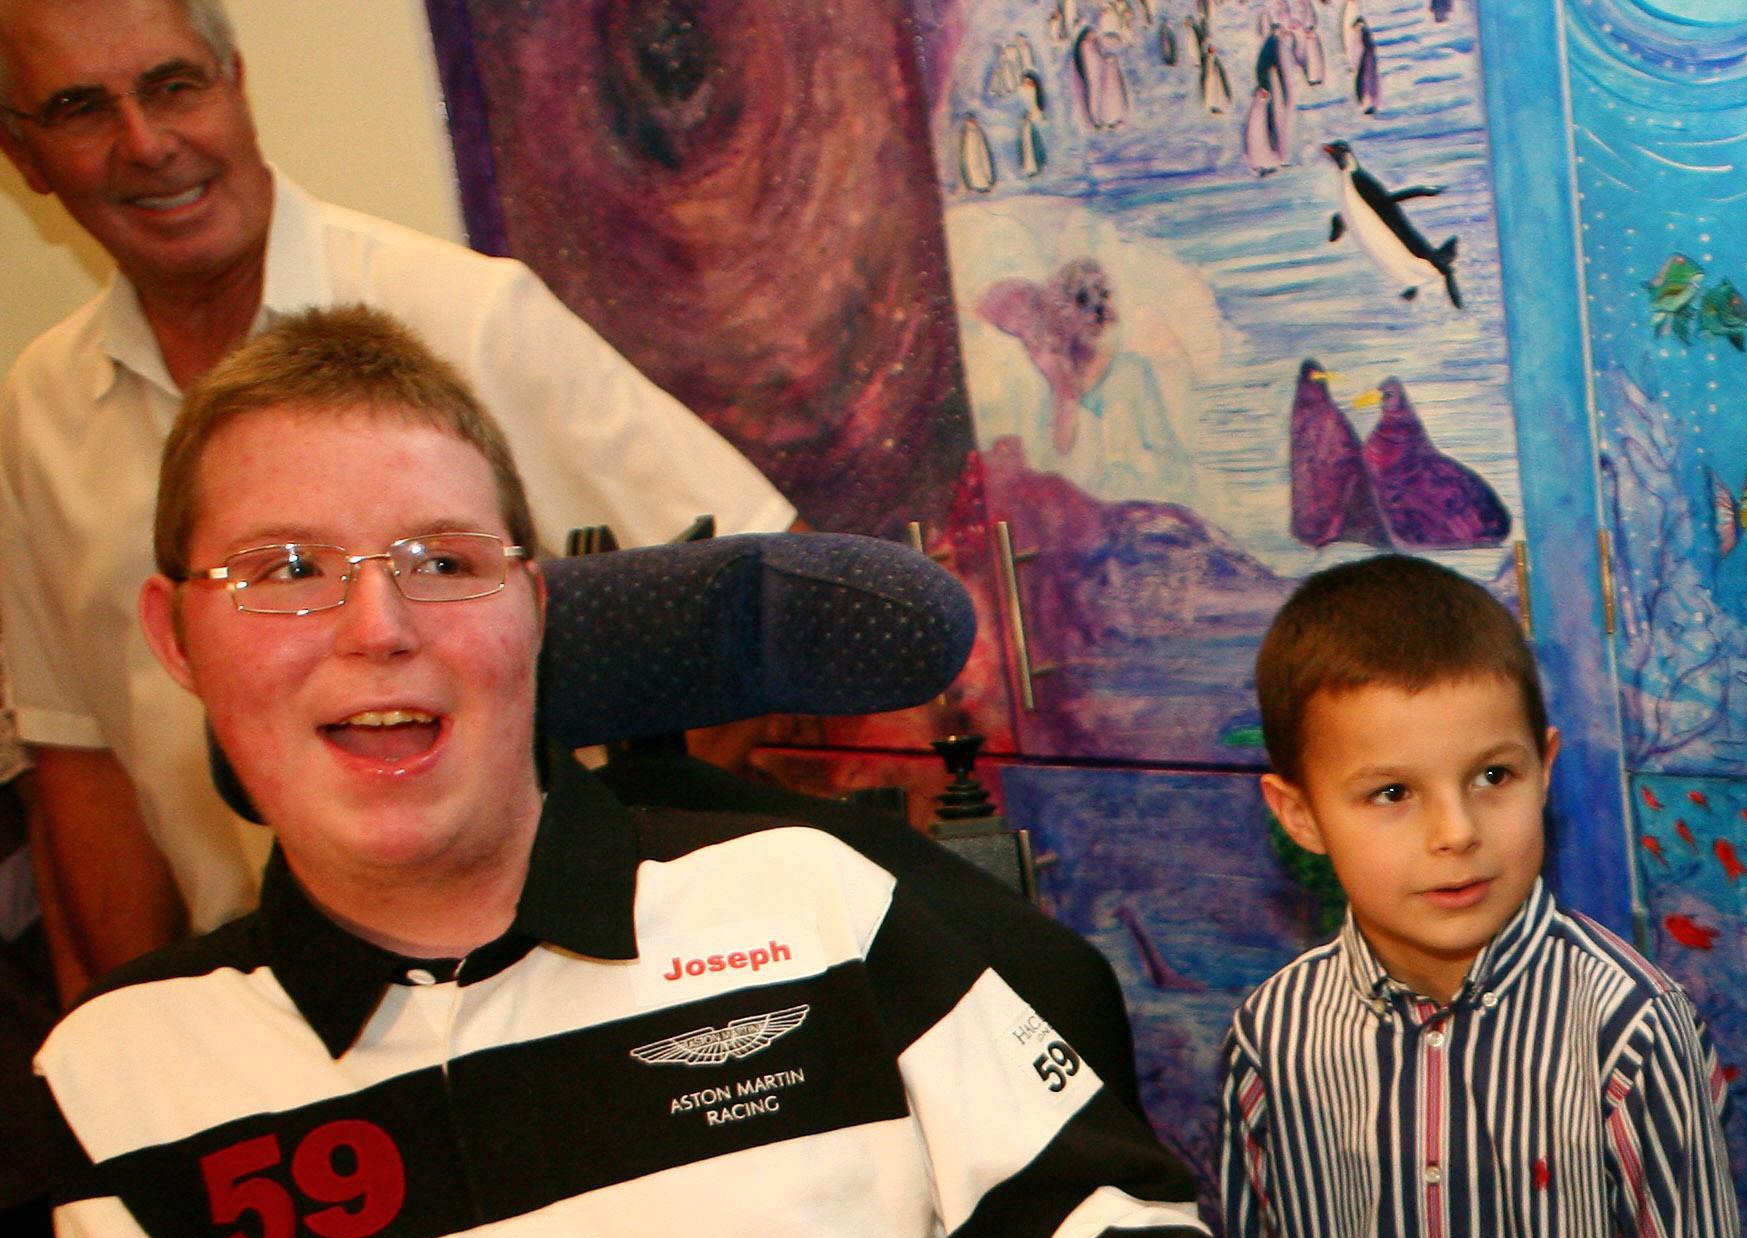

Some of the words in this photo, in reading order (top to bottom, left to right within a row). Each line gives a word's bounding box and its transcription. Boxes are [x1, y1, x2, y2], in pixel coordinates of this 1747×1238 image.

[663, 939, 792, 981] Joseph
[1012, 1014, 1045, 1045] HAC
[1032, 1040, 1081, 1092] 59
[670, 1085, 732, 1114] ASTON
[736, 1067, 805, 1097] MARTIN
[706, 1095, 779, 1126] RACING
